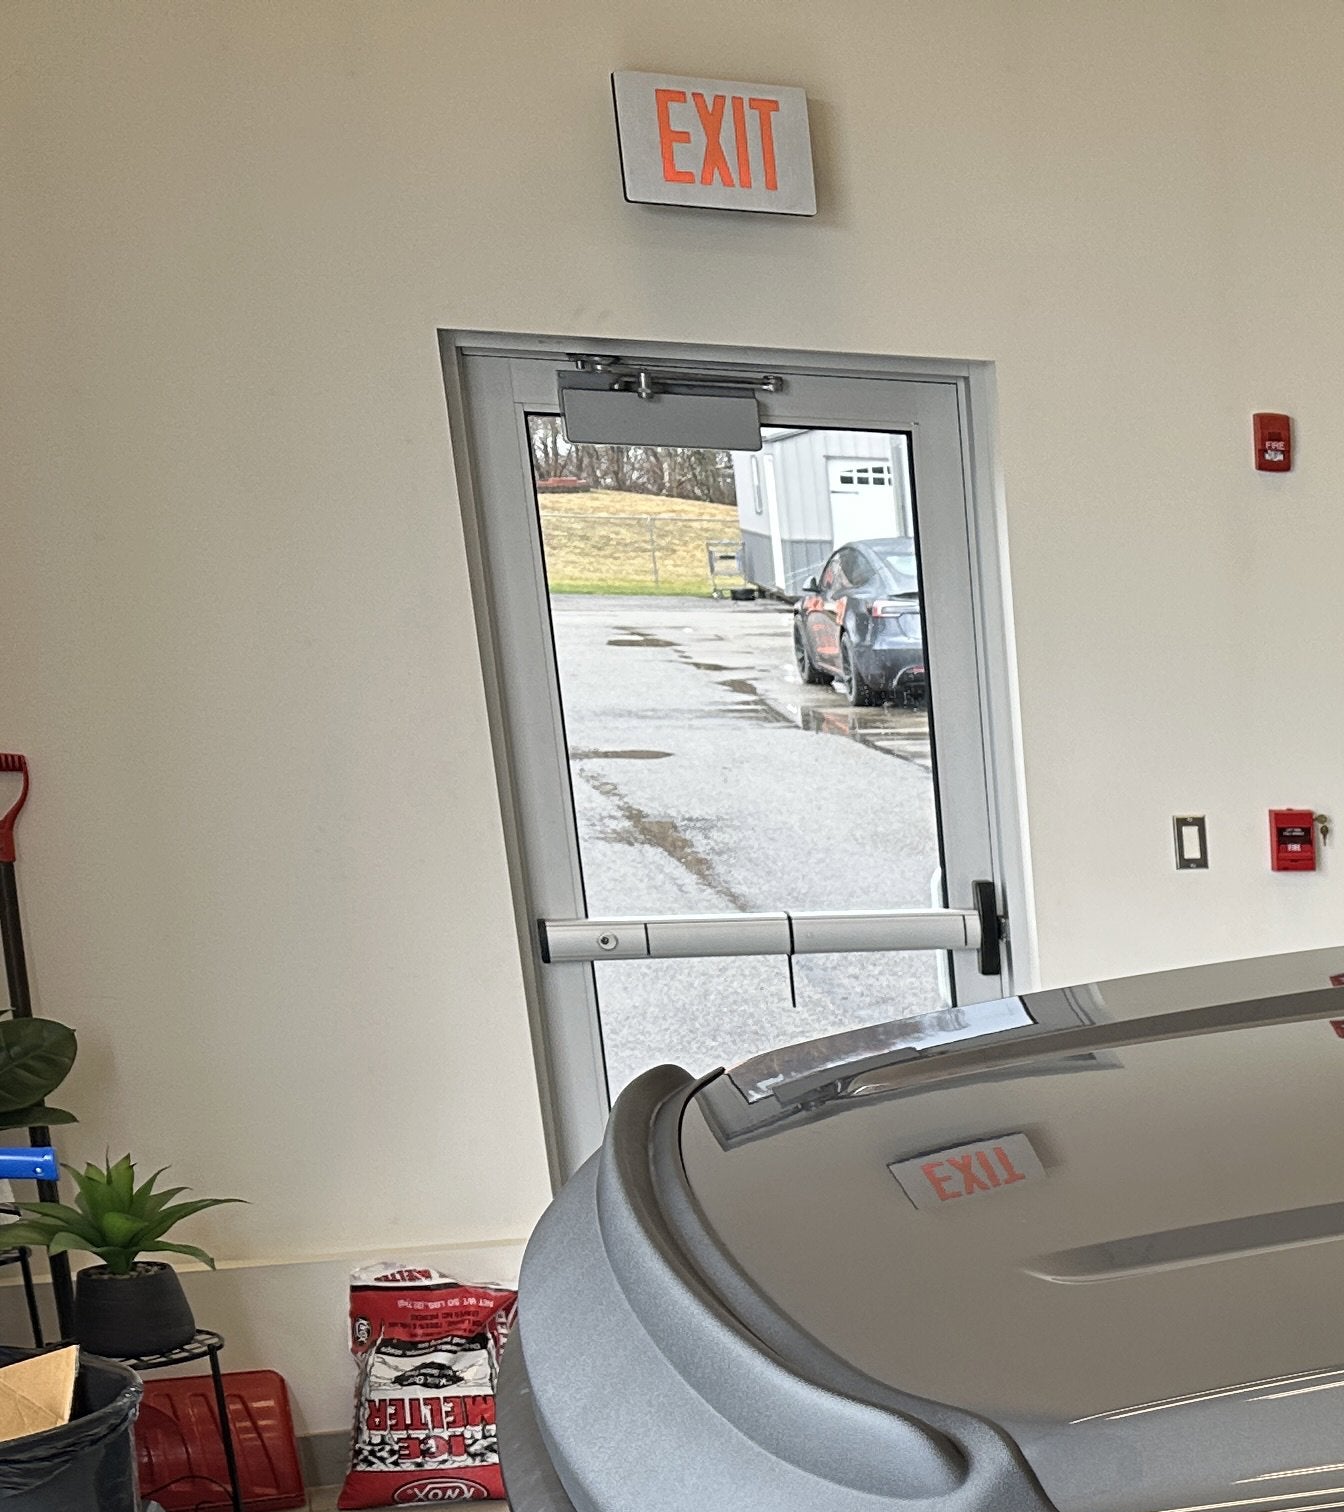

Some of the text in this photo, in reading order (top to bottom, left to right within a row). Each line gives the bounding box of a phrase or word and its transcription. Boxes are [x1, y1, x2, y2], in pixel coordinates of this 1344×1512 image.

[655, 88, 780, 191] EXIT
[366, 1394, 497, 1432] MELTER
[397, 1434, 468, 1462] ICE
[413, 1484, 475, 1500] KNOX
